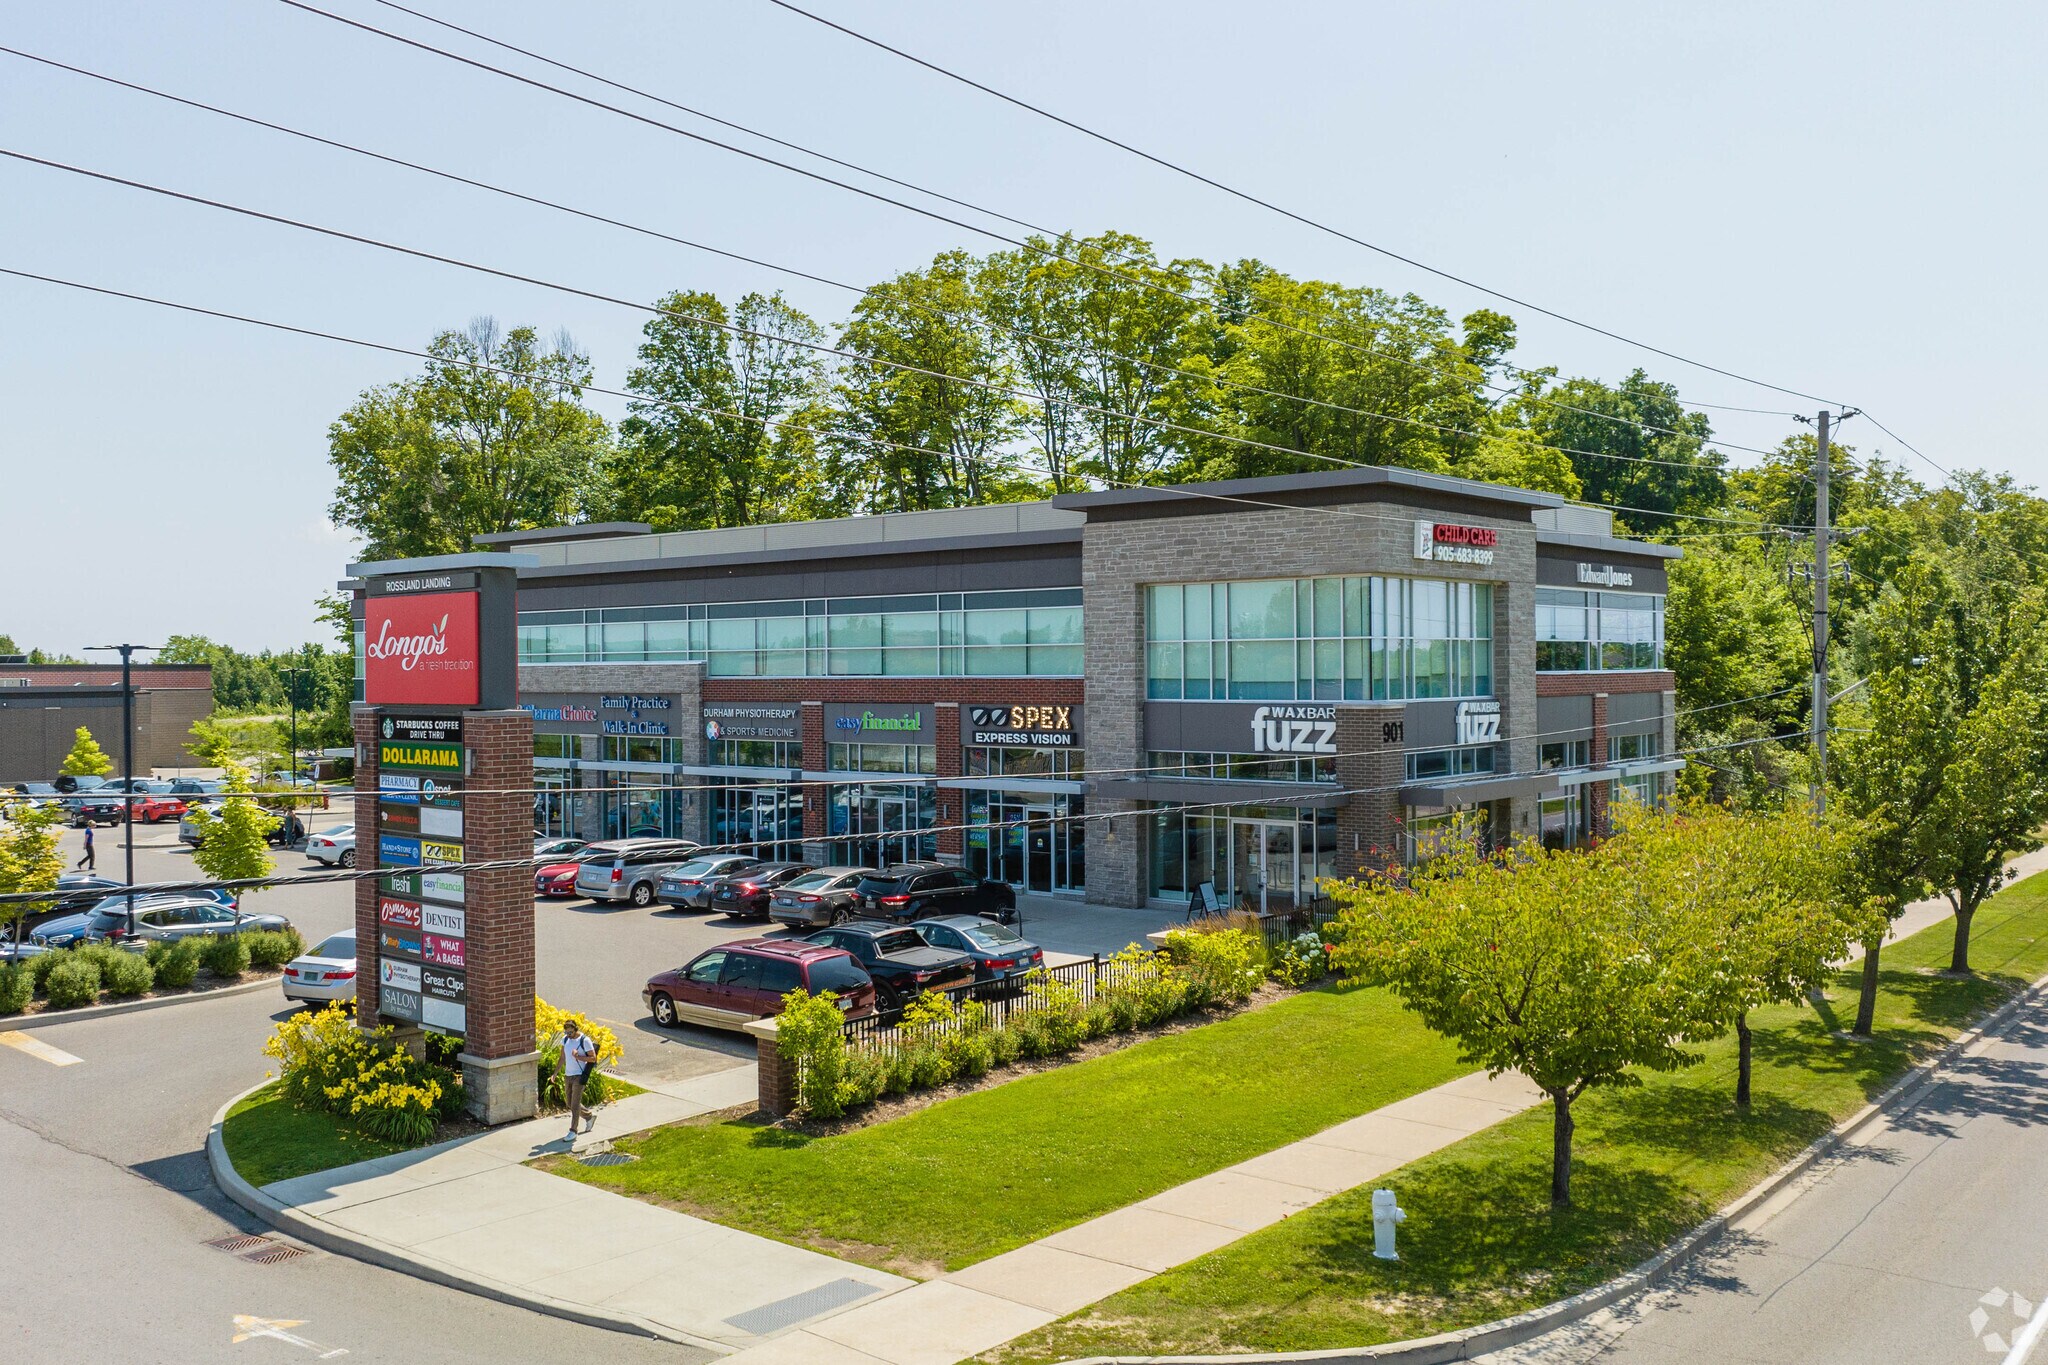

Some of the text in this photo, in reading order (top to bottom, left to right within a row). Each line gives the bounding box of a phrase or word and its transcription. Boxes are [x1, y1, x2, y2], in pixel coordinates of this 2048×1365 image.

[1436, 525, 1497, 546] CHILD CARE
[1437, 545, 1494, 565] 905-683-8399
[386, 577, 451, 592] ROSSLAND LANDING
[600, 696, 670, 713] Family Practice
[703, 708, 797, 719] DURHAM PHYSIOTHERAPY
[1010, 705, 1072, 730] SPEX
[396, 720, 460, 730] STARBUCKS COFFEE
[601, 721, 668, 735] Walk-In Clinic
[1251, 706, 1337, 753] fuzz
[1456, 701, 1500, 744] fuzz
[409, 730, 445, 740] DRIVE THRU
[726, 727, 756, 736] SPORTS
[757, 727, 795, 738] MEDICINE
[975, 732, 1072, 745] EXPRESS VISION
[1382, 721, 1404, 743] 901
[382, 747, 459, 767] DOLLARAMA
[381, 776, 418, 788] PHARMACY
[426, 912, 463, 930] DENTIST
[440, 939, 460, 952] WHAT
[436, 953, 465, 967] A BAGEL
[423, 972, 445, 987] Great
[446, 976, 465, 993] Clips
[384, 989, 417, 1010] SALON
[431, 987, 456, 998] HAIRCUTS
